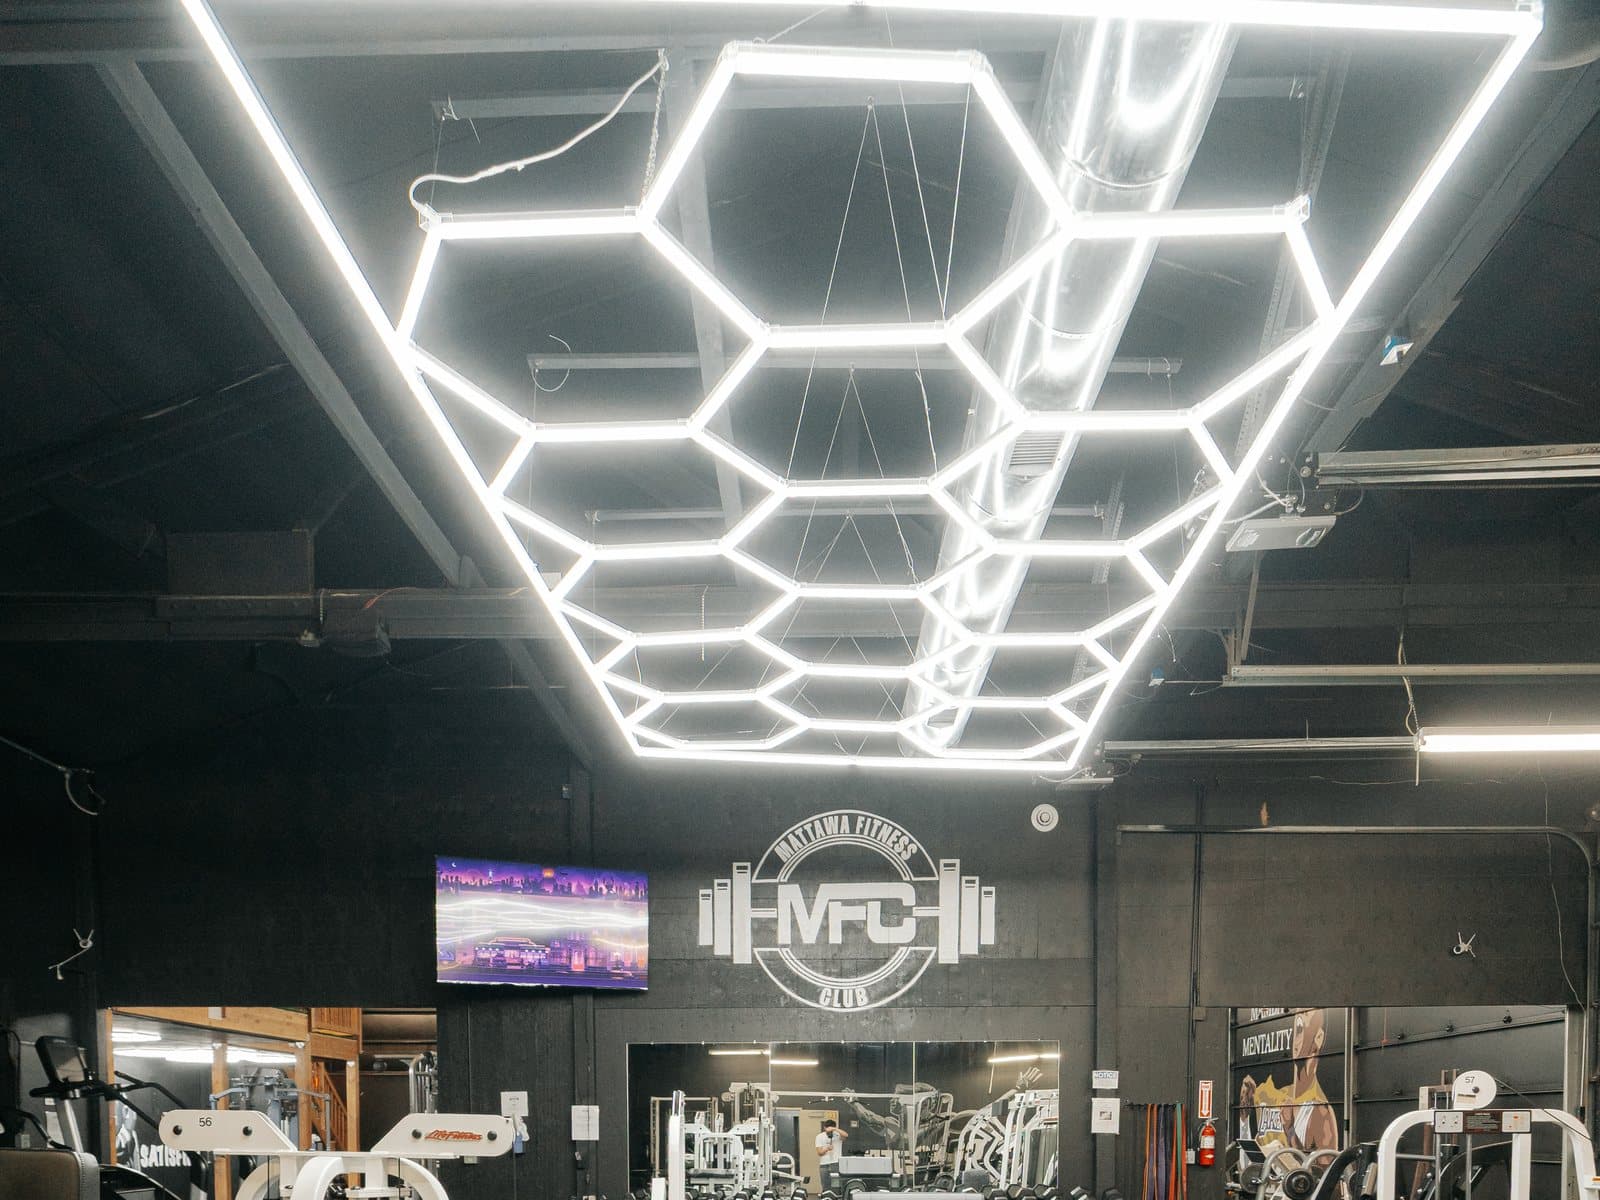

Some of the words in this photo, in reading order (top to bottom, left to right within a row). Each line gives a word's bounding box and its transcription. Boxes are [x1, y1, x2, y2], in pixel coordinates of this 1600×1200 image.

[774, 815, 850, 862] MATTAWA
[855, 816, 918, 861] FITNESS
[777, 882, 916, 944] MFC
[819, 987, 869, 1007] CLUB
[1242, 1028, 1293, 1057] MENTALITY
[199, 1117, 212, 1127] 56
